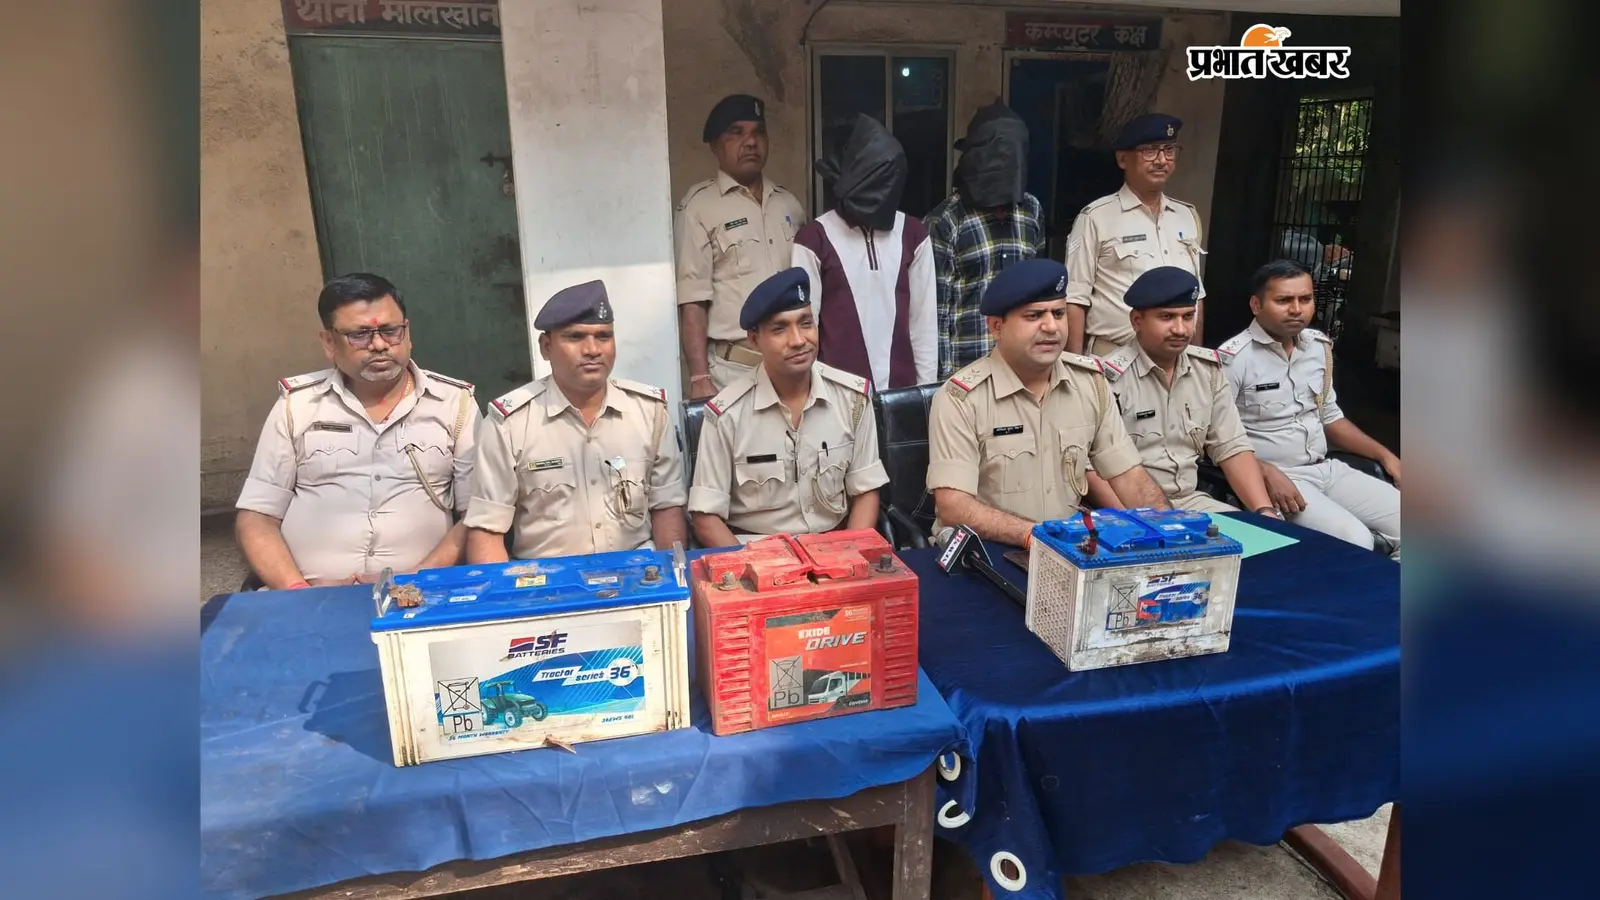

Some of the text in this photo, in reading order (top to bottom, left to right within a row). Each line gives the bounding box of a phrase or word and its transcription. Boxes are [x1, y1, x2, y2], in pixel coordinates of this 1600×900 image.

[1113, 25, 1147, 47] कक्ष
[1115, 612, 1129, 629] Pb
[534, 632, 568, 650] SF
[805, 631, 867, 651] DRIVE
[507, 648, 565, 660] BATTERIES
[610, 665, 631, 680] 36
[773, 689, 800, 708] Pb
[453, 714, 473, 733] Pb
